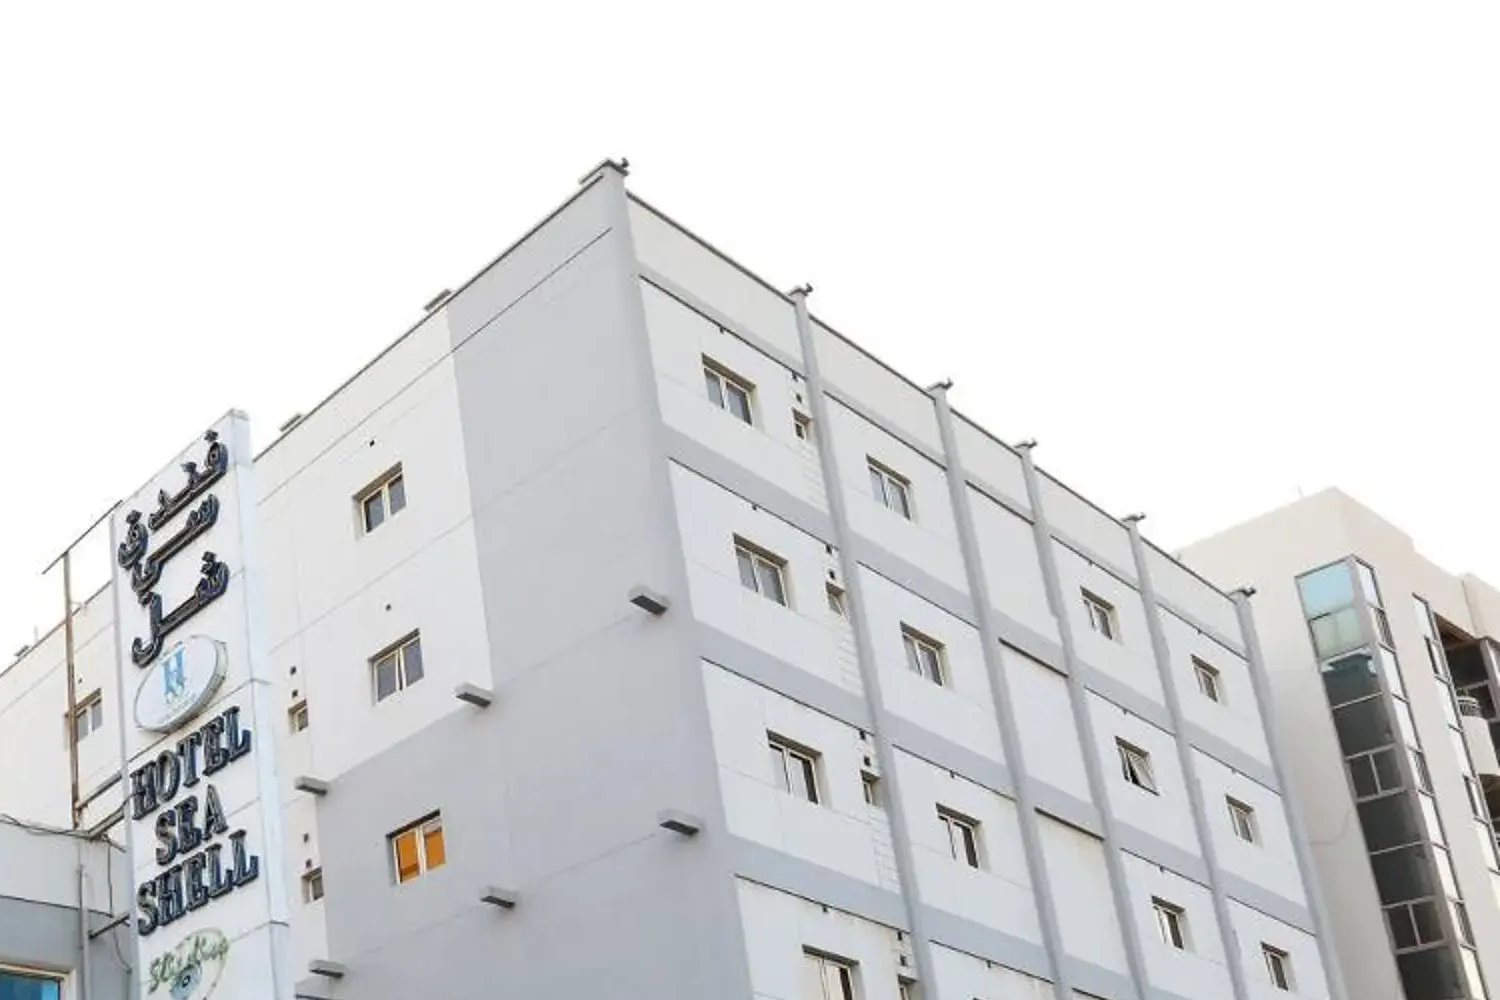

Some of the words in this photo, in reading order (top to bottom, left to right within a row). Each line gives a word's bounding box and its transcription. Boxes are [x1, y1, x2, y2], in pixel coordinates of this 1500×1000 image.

[118, 429, 228, 570] فندق
[130, 706, 252, 820] HOTEL
[155, 784, 229, 866] SEA
[137, 829, 259, 936] SHELL
